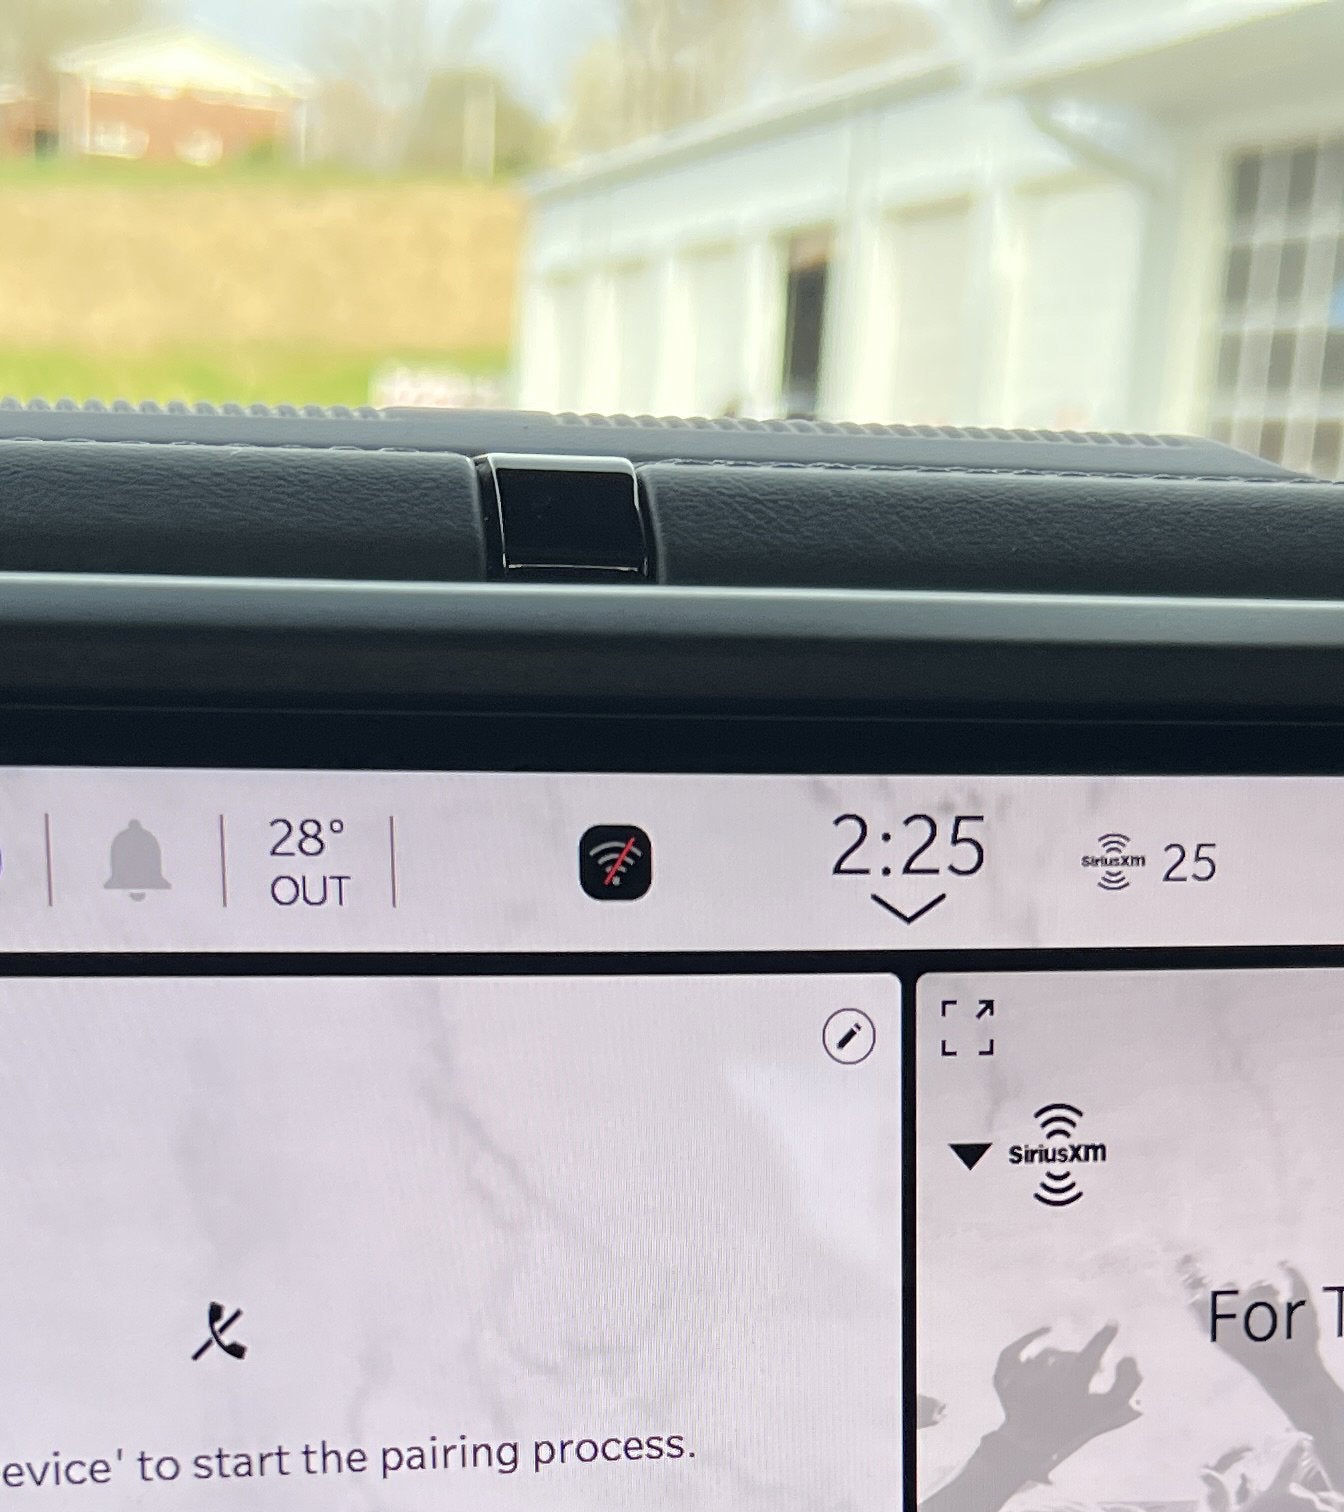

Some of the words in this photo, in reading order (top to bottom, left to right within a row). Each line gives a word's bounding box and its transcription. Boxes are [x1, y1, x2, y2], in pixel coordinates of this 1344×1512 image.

[832, 813, 985, 877] 2:25
[1162, 843, 1216, 882] 25
[270, 875, 351, 906] OUT
[1210, 1289, 1307, 1343] For
[137, 1450, 180, 1482] to
[193, 1444, 290, 1479] start
[301, 1440, 368, 1475] the
[381, 1434, 519, 1479] pairing
[534, 1433, 696, 1473] process.
